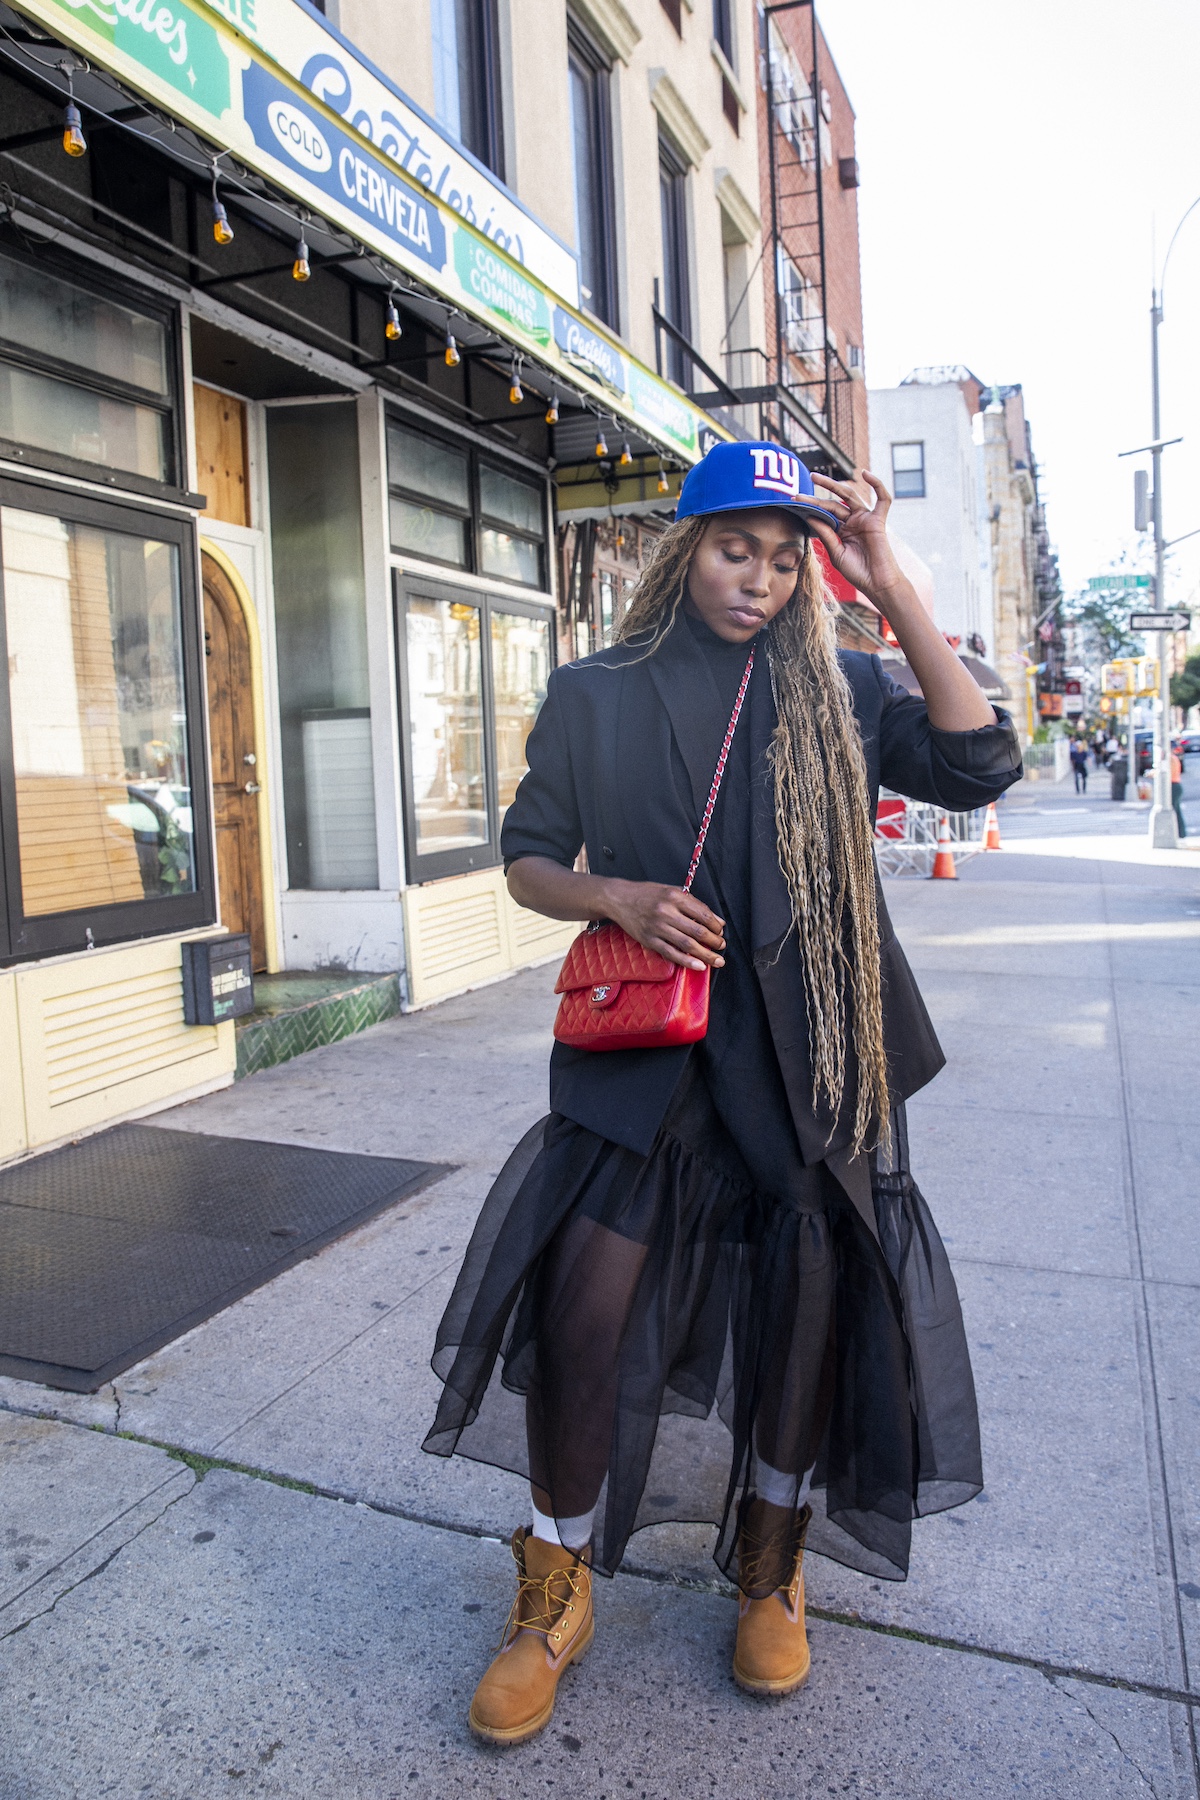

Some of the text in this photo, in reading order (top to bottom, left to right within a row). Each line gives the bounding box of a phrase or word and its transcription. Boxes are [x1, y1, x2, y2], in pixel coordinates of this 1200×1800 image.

[276, 111, 432, 253] COLD CERVEZA
[470, 268, 534, 331] COMIDAS
[475, 247, 537, 311] COMIDAS
